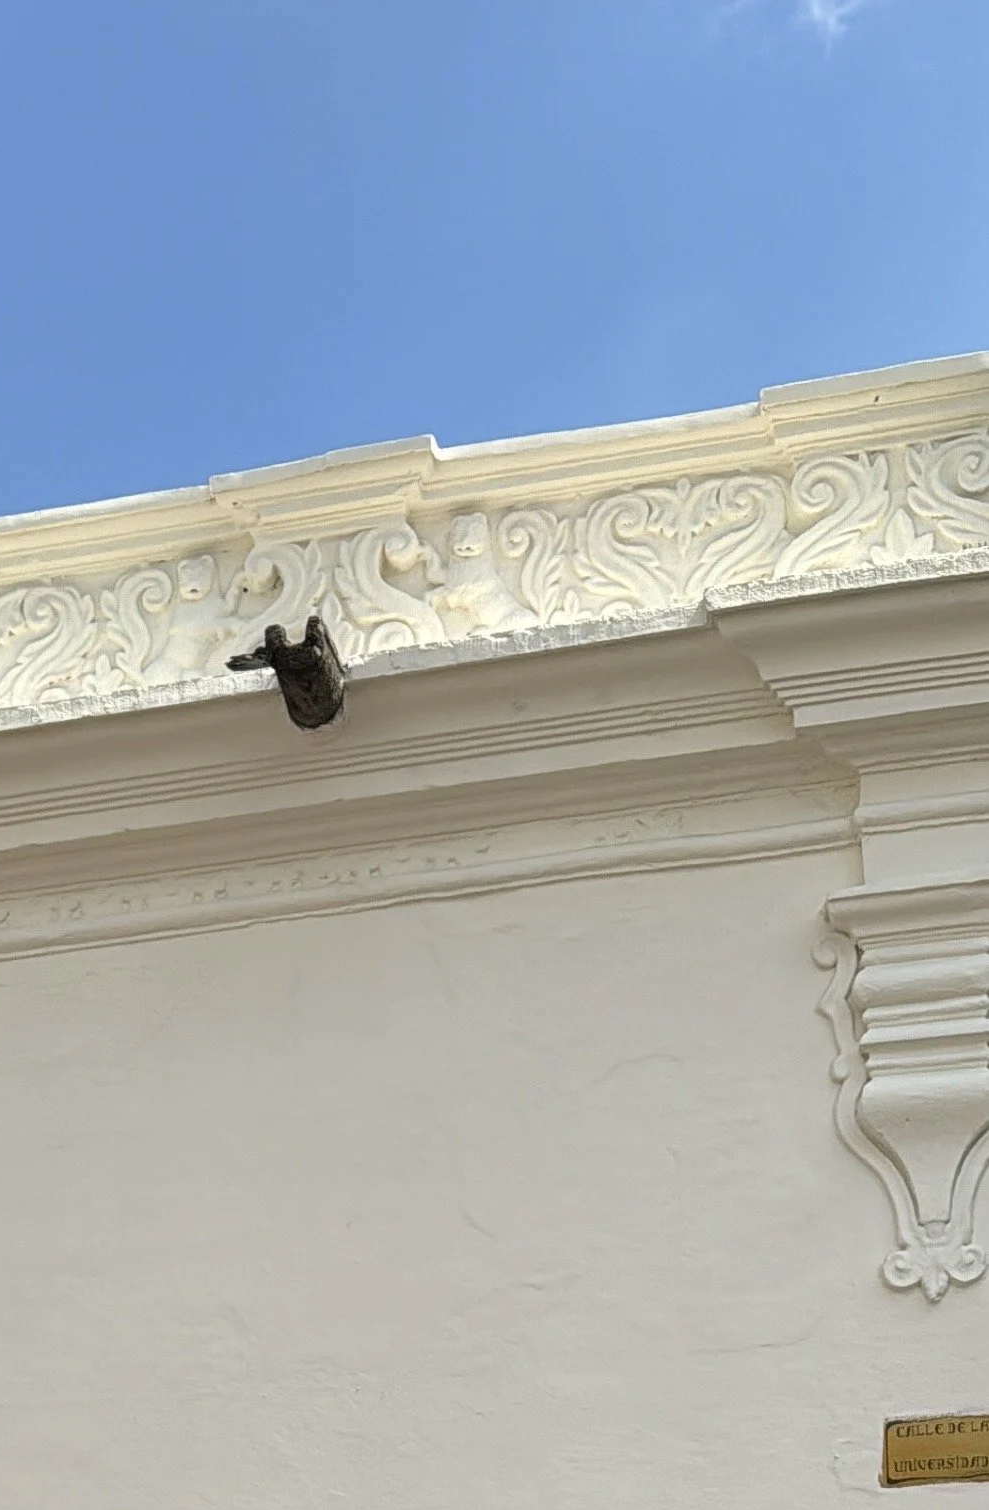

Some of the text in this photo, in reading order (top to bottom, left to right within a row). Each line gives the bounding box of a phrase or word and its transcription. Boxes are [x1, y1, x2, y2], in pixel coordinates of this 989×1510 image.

[896, 1420, 989, 1438] CALLE DE LA
[894, 1455, 989, 1472] UNIVERSIDAD
